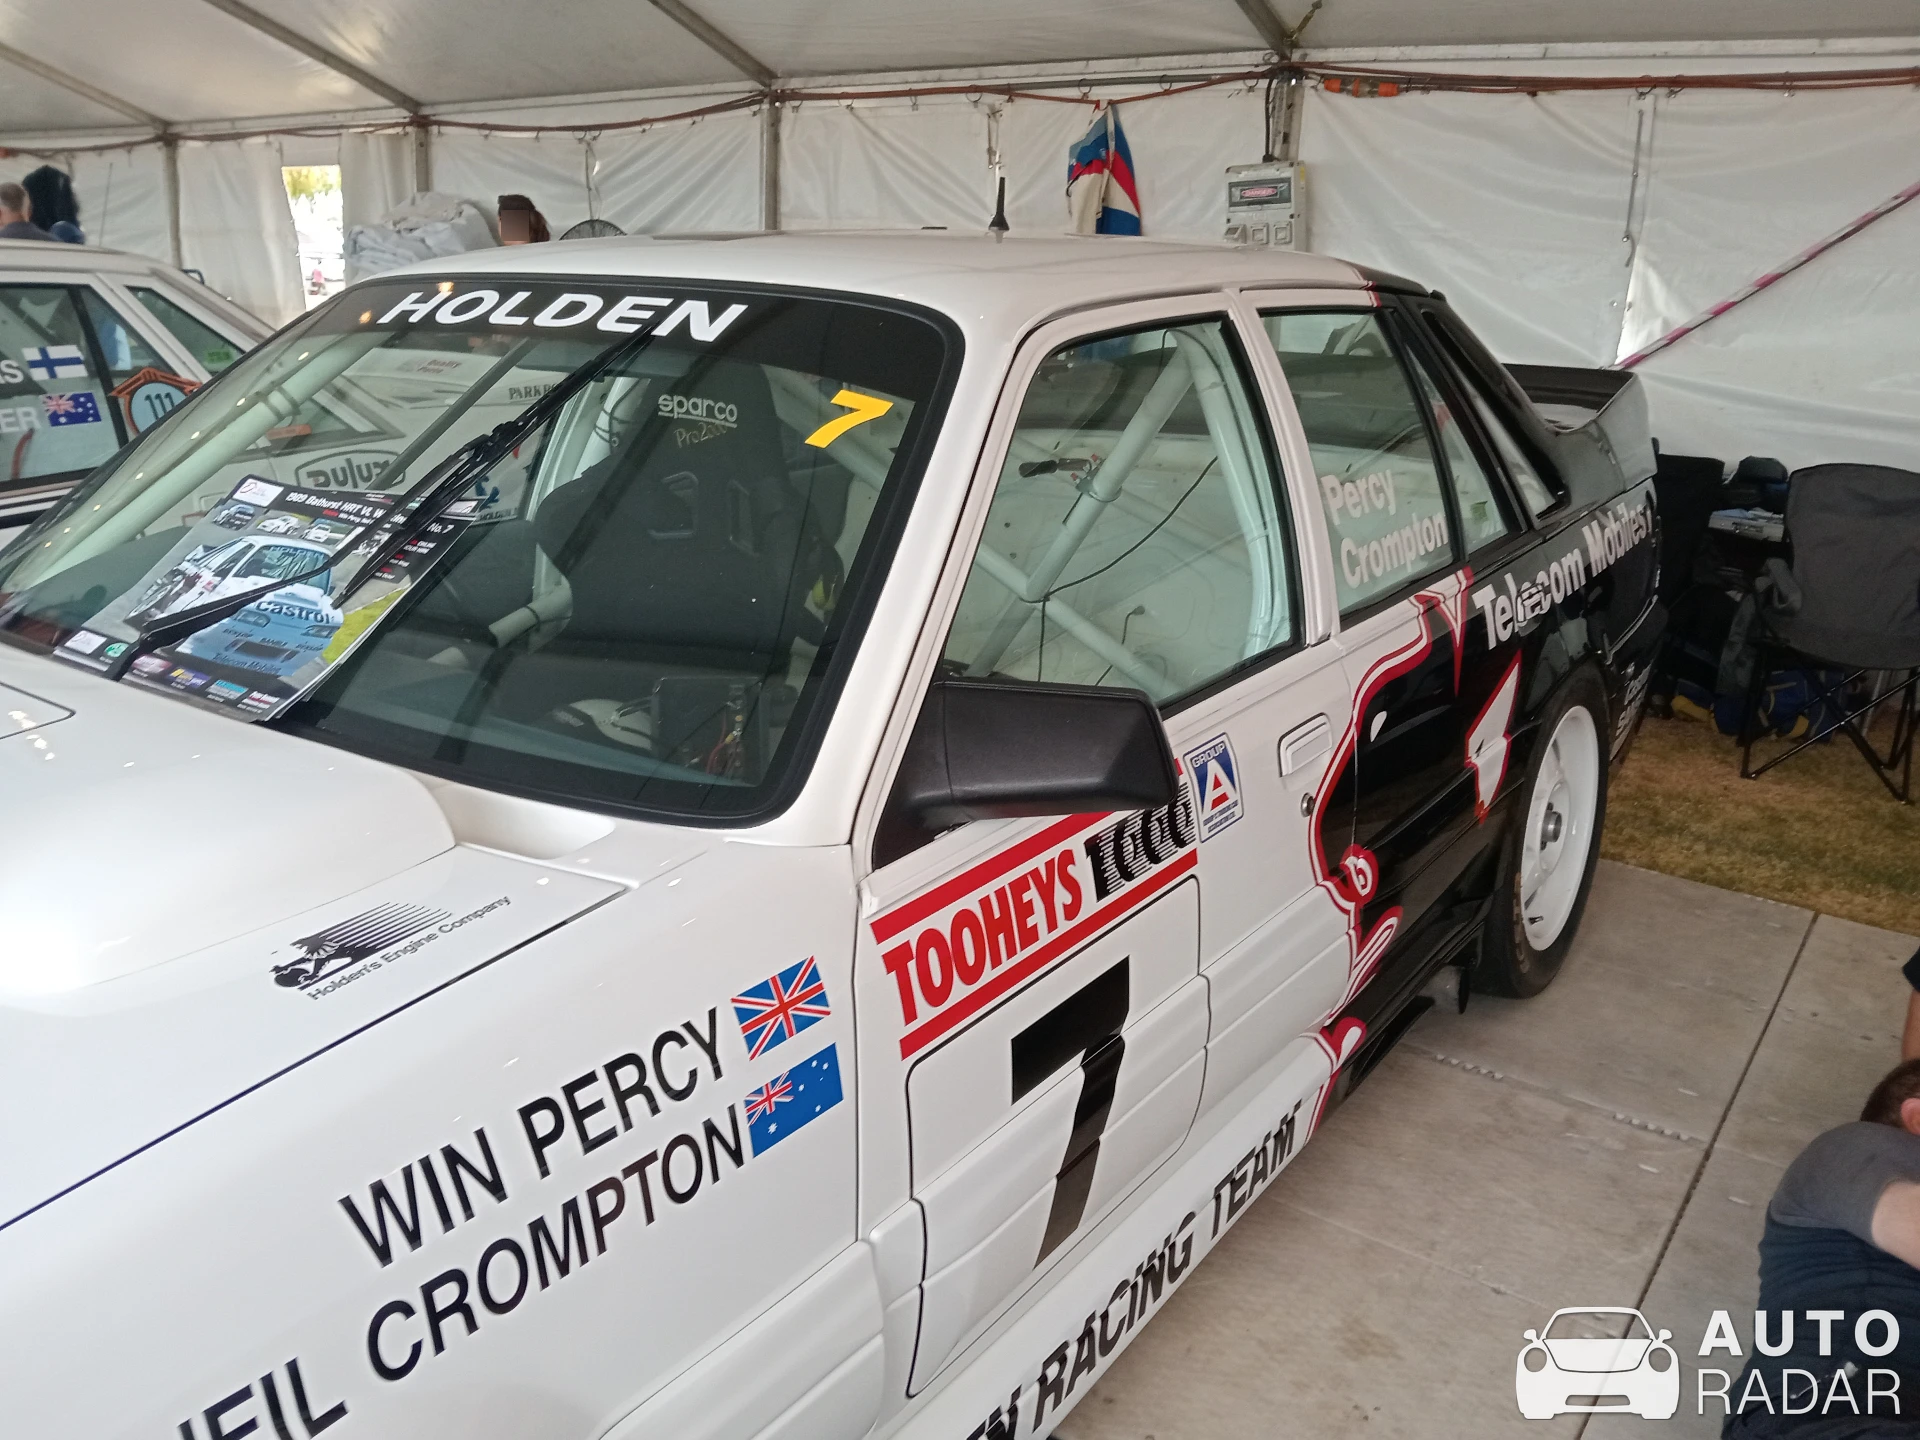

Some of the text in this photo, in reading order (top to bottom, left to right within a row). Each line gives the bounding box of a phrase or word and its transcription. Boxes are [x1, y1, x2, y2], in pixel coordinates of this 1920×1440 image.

[377, 289, 748, 342] HOLDEN
[658, 394, 738, 422] sparco
[804, 388, 895, 449] 7
[305, 495, 341, 510] Bathurst
[340, 501, 363, 514] HRT
[1320, 468, 1398, 525] Percy
[426, 522, 442, 533] No.
[1340, 510, 1450, 588] Crompton
[1472, 502, 1652, 650] Telecom Mobiles
[255, 600, 330, 624] Castrol
[1192, 741, 1226, 769] GROUP
[1201, 758, 1237, 815] A
[882, 782, 1197, 1027] TOOHEYS 1000
[306, 896, 511, 1000] Holden's Engine Company
[337, 1005, 726, 1269] WIN PERCY
[1011, 955, 1130, 1270] 7
[366, 1103, 746, 1382] CROMPTON
[1032, 1210, 1197, 1434] RACING
[1210, 1098, 1303, 1242] TEAM
